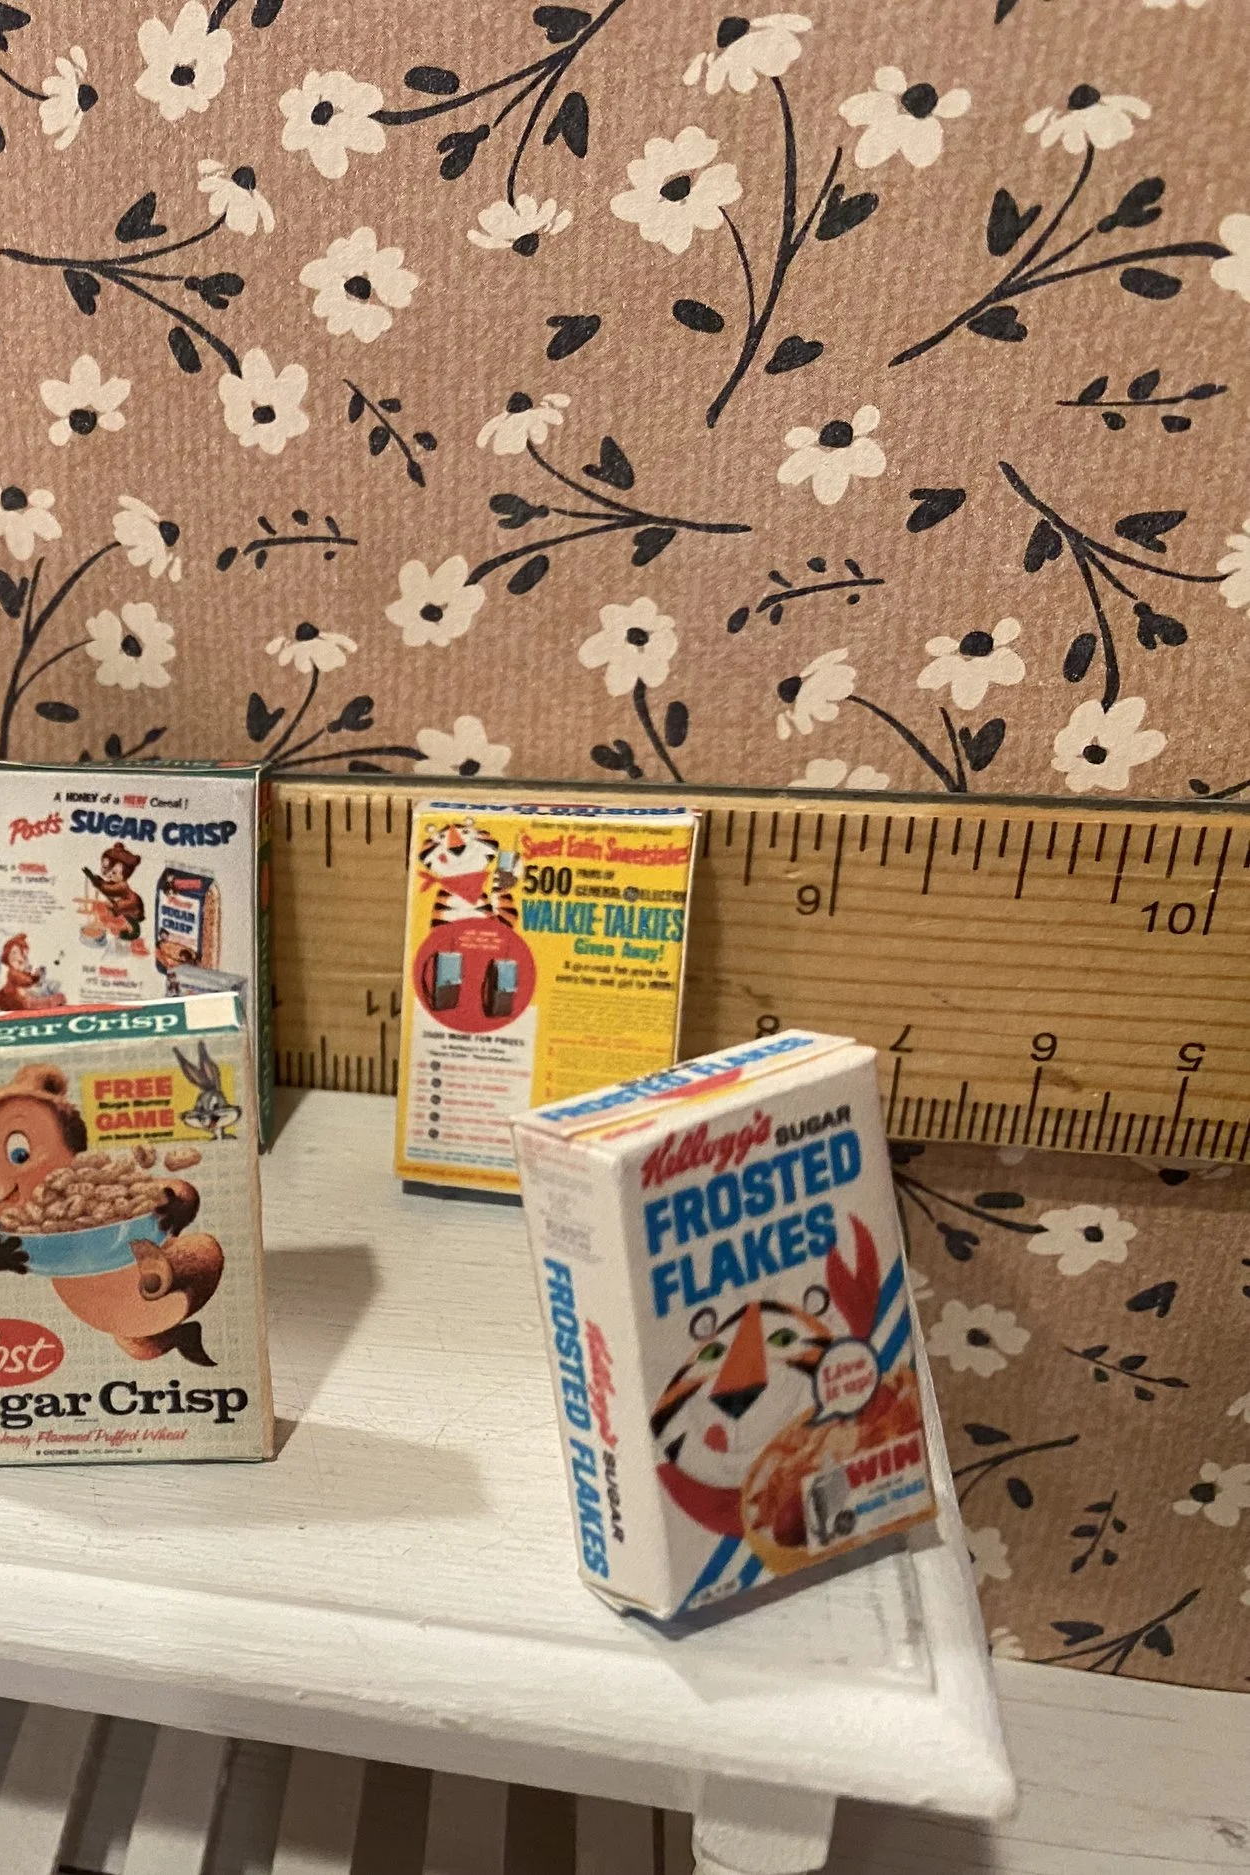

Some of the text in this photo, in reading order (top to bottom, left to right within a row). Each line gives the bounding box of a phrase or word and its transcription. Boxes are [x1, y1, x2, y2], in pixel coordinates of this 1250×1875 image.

[66, 793, 98, 803] HONEY
[9, 809, 238, 847] Post's SUGAR CRISP
[522, 865, 573, 896] 500
[161, 905, 195, 924] SUGAR
[796, 884, 822, 916] 9
[162, 918, 193, 935] CRISP
[522, 899, 685, 943] WALKIE-TALKIES
[1140, 901, 1197, 935] 10
[366, 989, 401, 1018] 11
[67, 1010, 179, 1037] Crisp
[755, 1014, 780, 1039] 8
[889, 1024, 914, 1054] 7
[1030, 1032, 1058, 1062] 6
[1177, 1042, 1207, 1073] 5
[94, 1075, 173, 1100] FREE
[95, 1109, 175, 1131] GAME
[641, 1104, 852, 1189] Kellogg's SUGAR
[642, 1128, 863, 1257] FROSTED
[651, 1201, 839, 1318] FLAKES
[99, 1379, 249, 1425] Crisp
[543, 1256, 592, 1432] FROSTED
[569, 1437, 611, 1579] FLAKES
[93, 1429, 139, 1447] Puffed
[141, 1426, 189, 1441] Wheat
[845, 1437, 922, 1490] WIN
[602, 1450, 626, 1546] SUGAR
